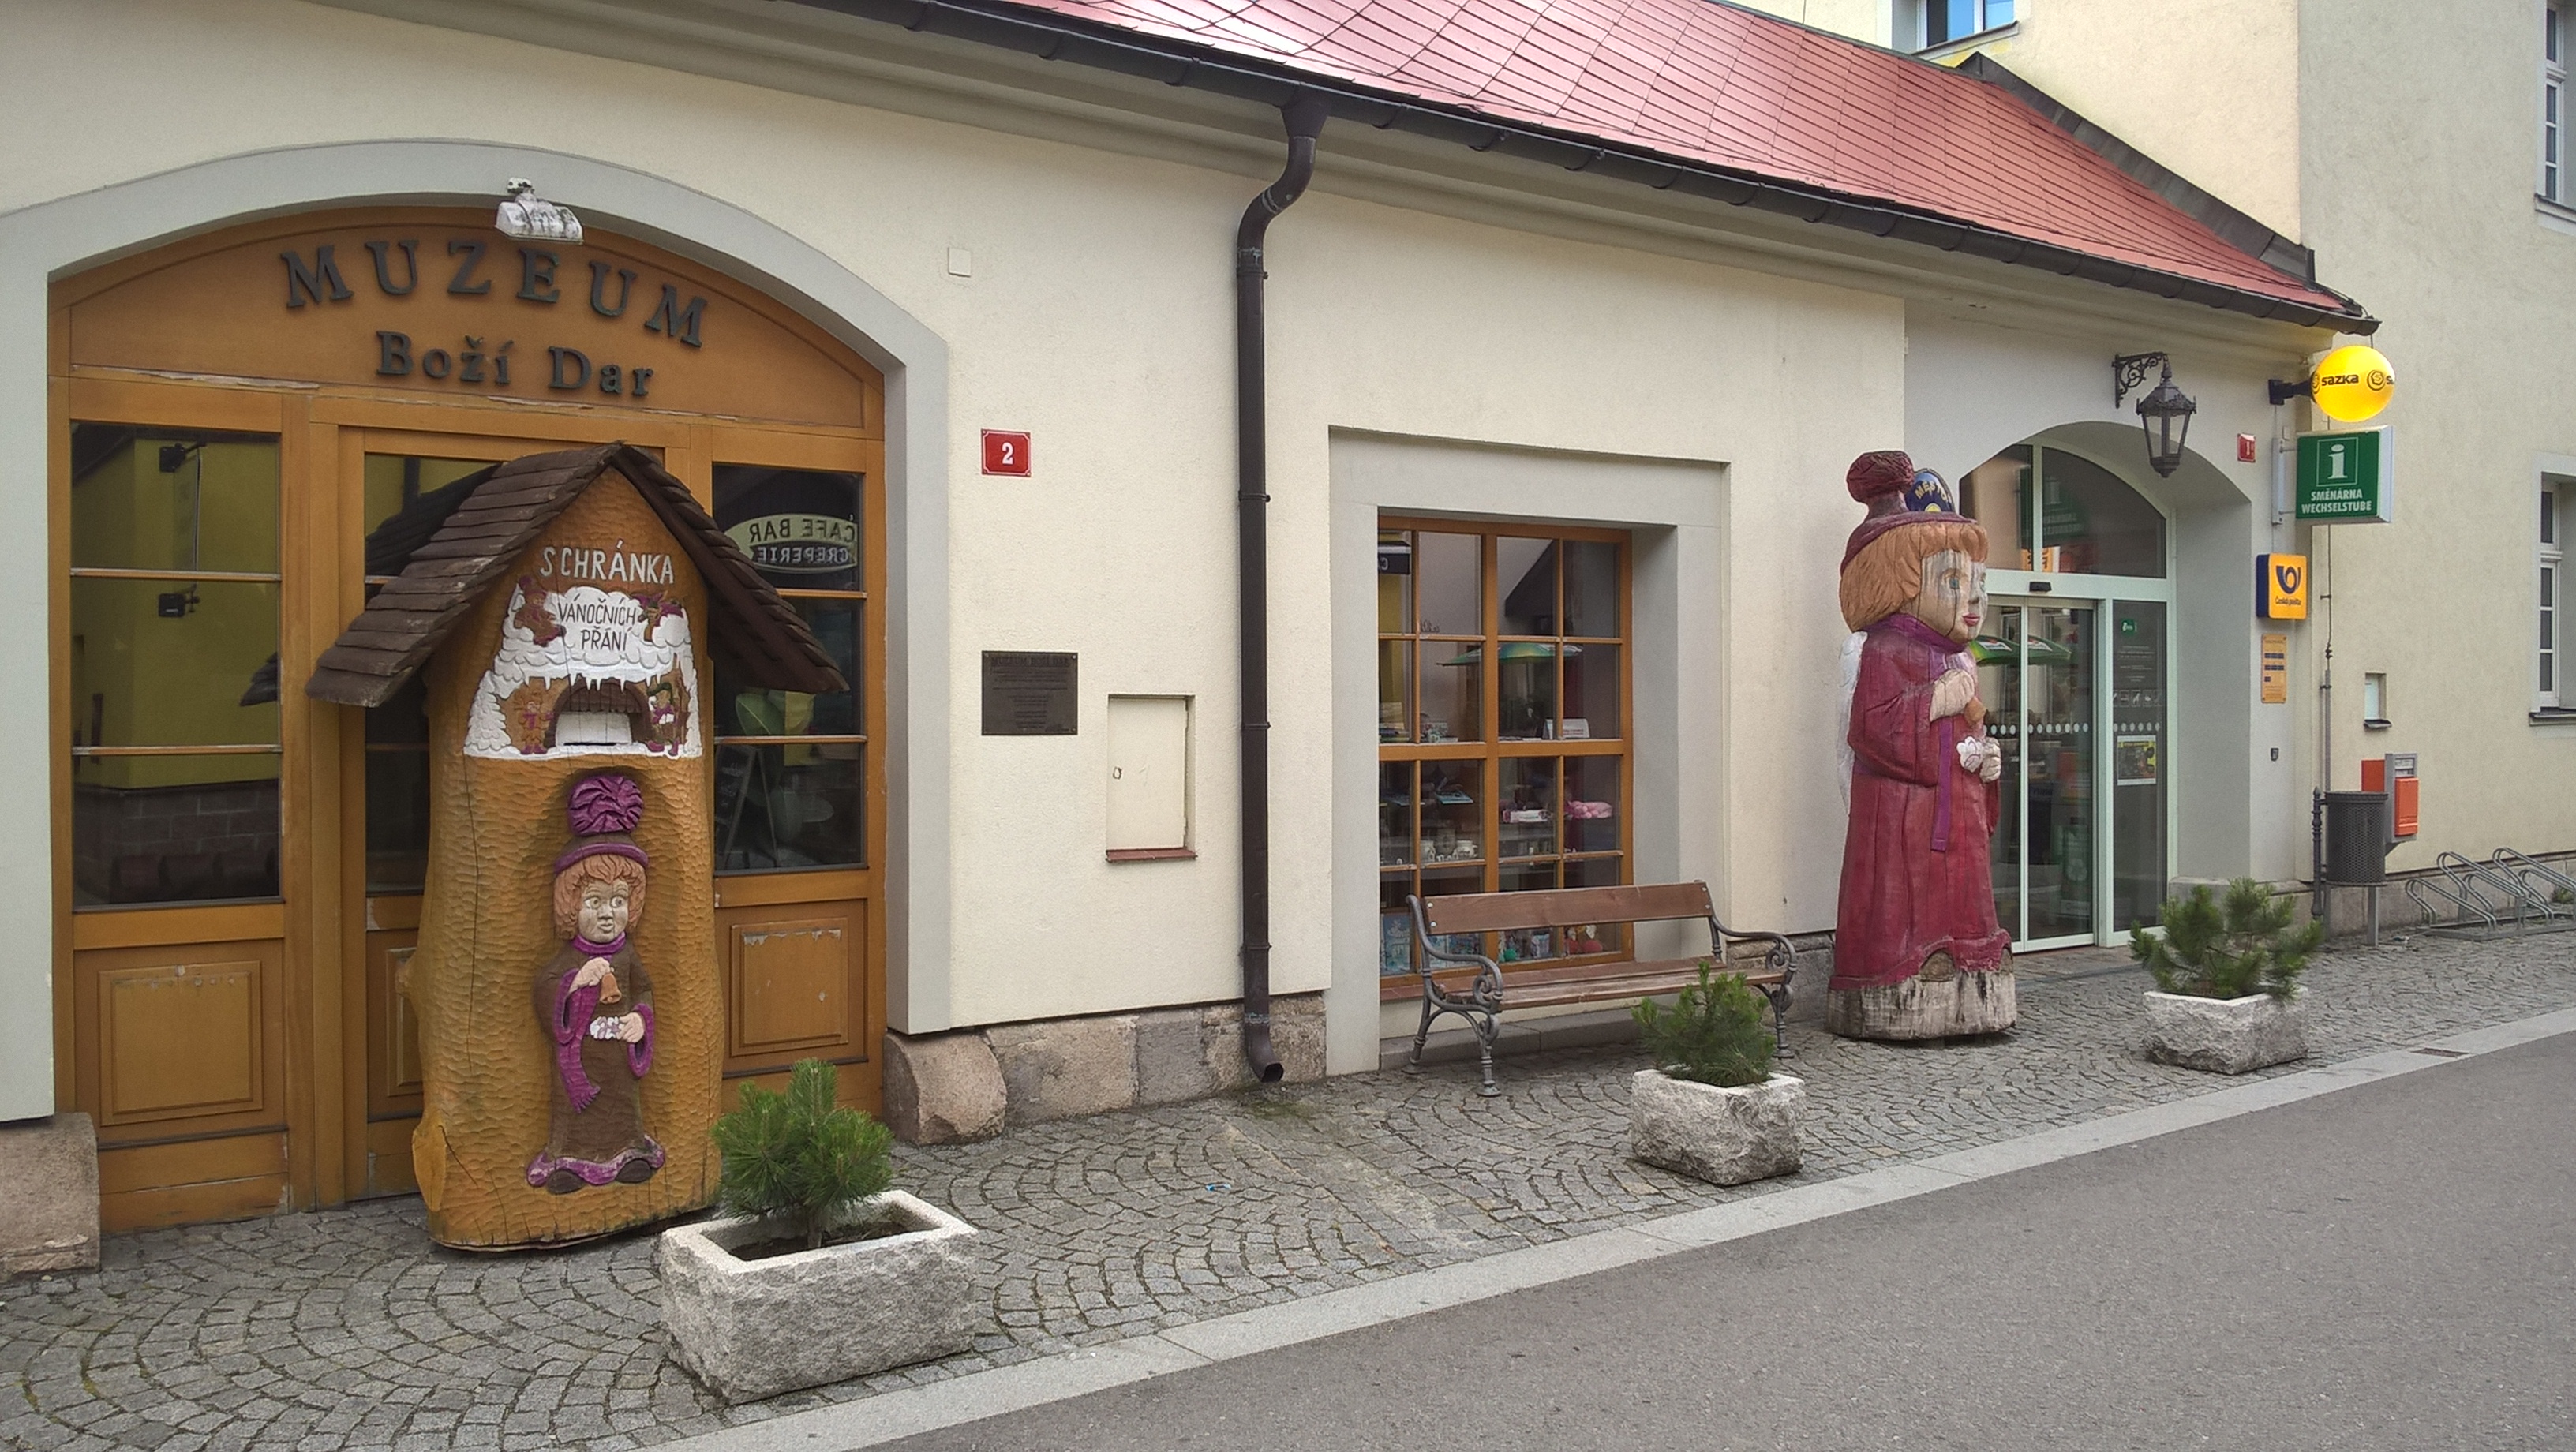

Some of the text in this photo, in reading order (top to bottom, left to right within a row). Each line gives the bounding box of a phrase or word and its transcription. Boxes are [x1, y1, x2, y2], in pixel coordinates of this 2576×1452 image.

[280, 240, 708, 348] MUZEUM
[376, 330, 654, 395] Boží Dar
[2321, 374, 2359, 386] sazka
[1001, 442, 1014, 465] 2
[2311, 488, 2363, 501] SMĚNÁRNA
[2301, 501, 2372, 514] WECHSELSTUBE
[540, 539, 675, 584] SCHRÁNKA
[558, 597, 637, 627] VÁNOČNÍCH
[580, 627, 632, 651] PŘÁNÍ
